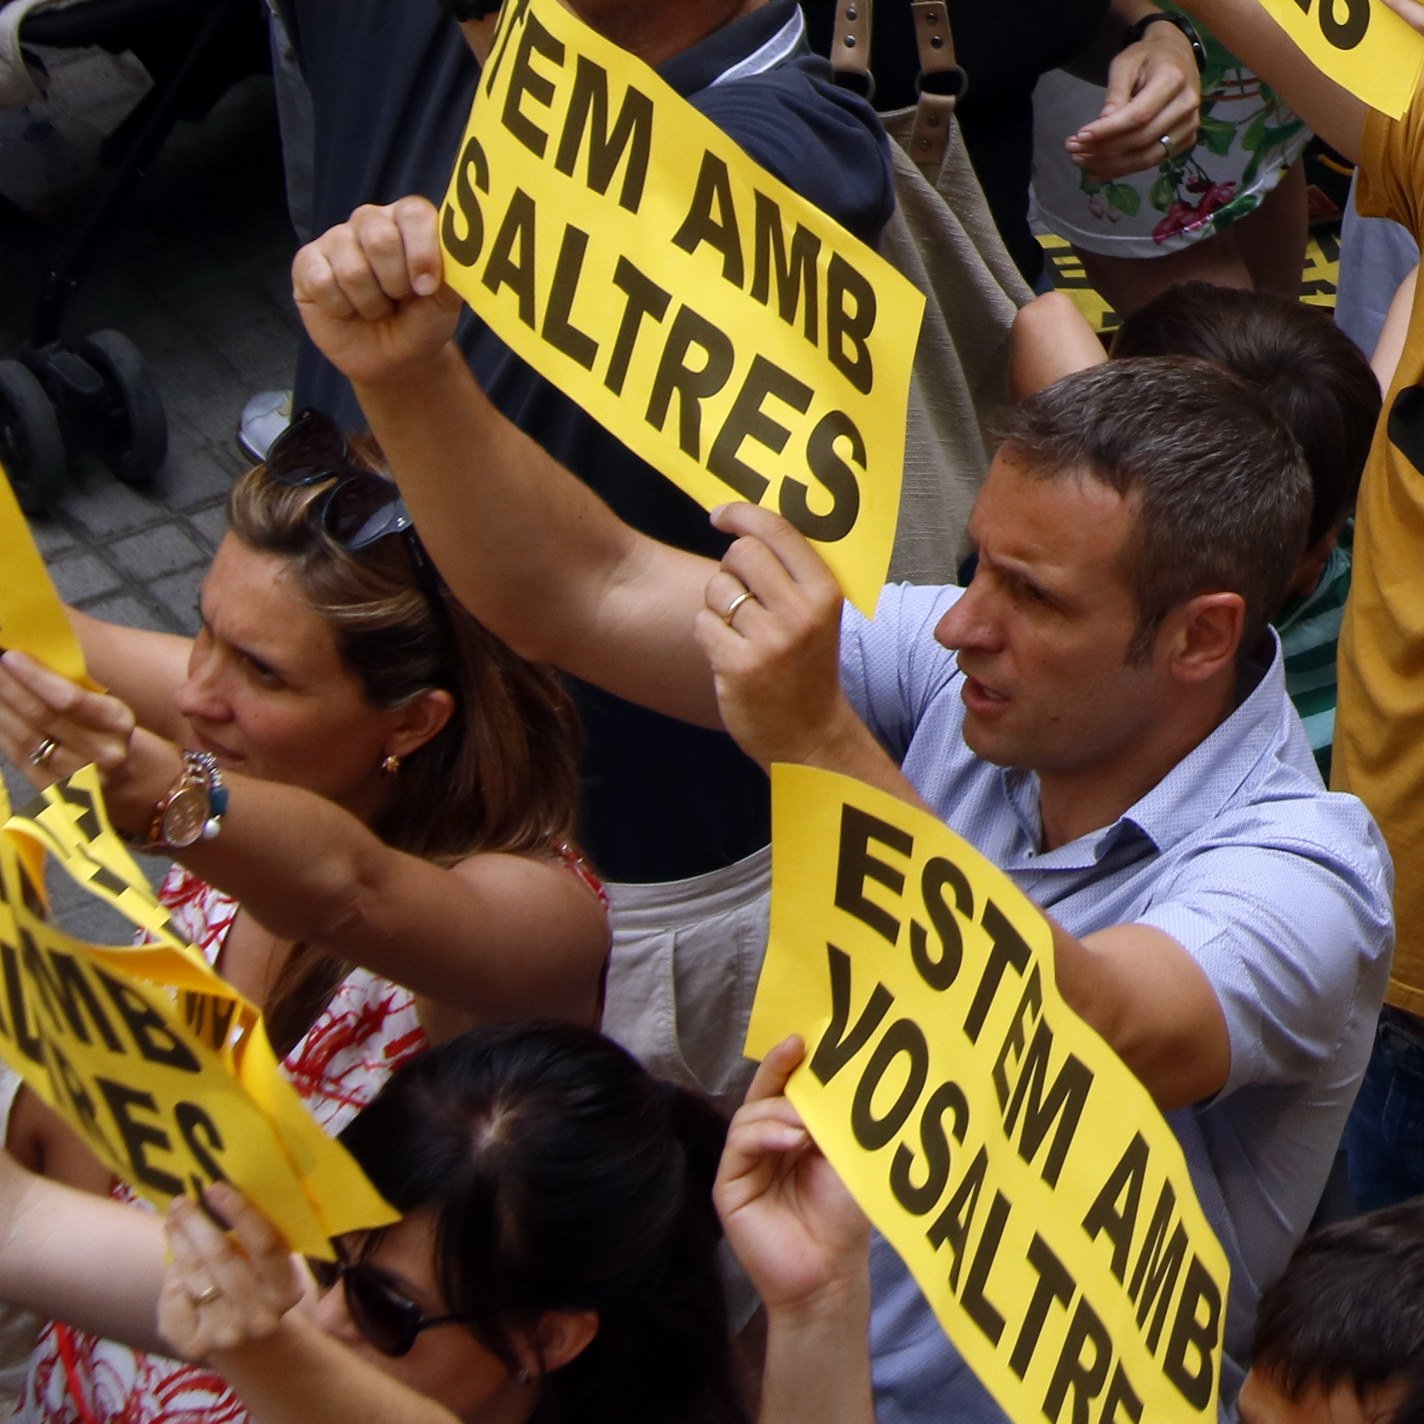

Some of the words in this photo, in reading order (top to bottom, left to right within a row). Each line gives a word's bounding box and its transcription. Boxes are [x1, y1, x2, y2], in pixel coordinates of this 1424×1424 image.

[671, 149, 878, 397] AMB
[832, 802, 1096, 1192] ESTEM
[1080, 1129, 1223, 1413] AMB
